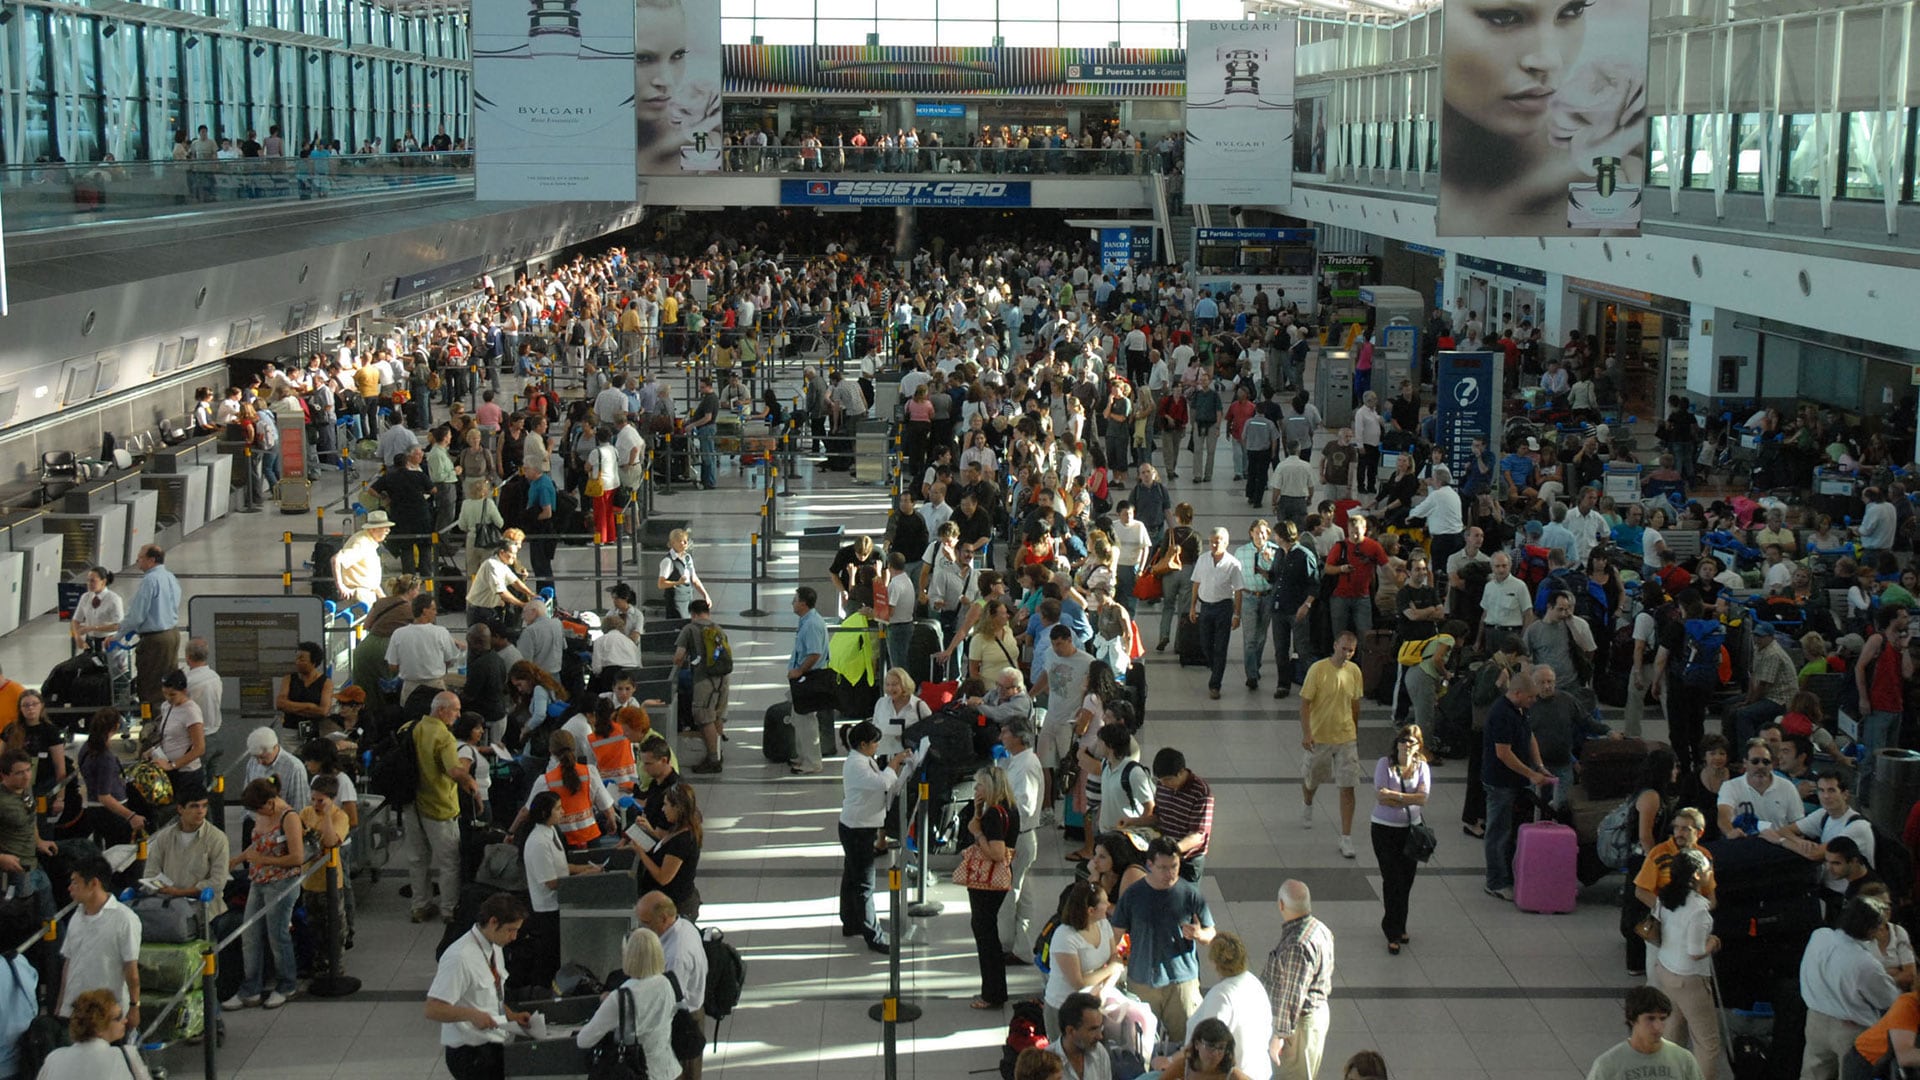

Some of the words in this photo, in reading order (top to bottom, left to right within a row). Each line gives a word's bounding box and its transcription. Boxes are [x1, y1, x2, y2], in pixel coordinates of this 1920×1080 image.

[1209, 22, 1278, 32] BVLGARI
[1105, 68, 1134, 76] Puertas
[518, 106, 593, 115] BVLGARI
[849, 195, 910, 206] Imprescindible
[912, 197, 932, 206] para
[945, 196, 965, 207] viaje
[1237, 231, 1266, 239] Departures
[1103, 241, 1125, 249] BANCO
[1103, 250, 1128, 258] CAMBIO
[1327, 256, 1368, 265] TrueStar
